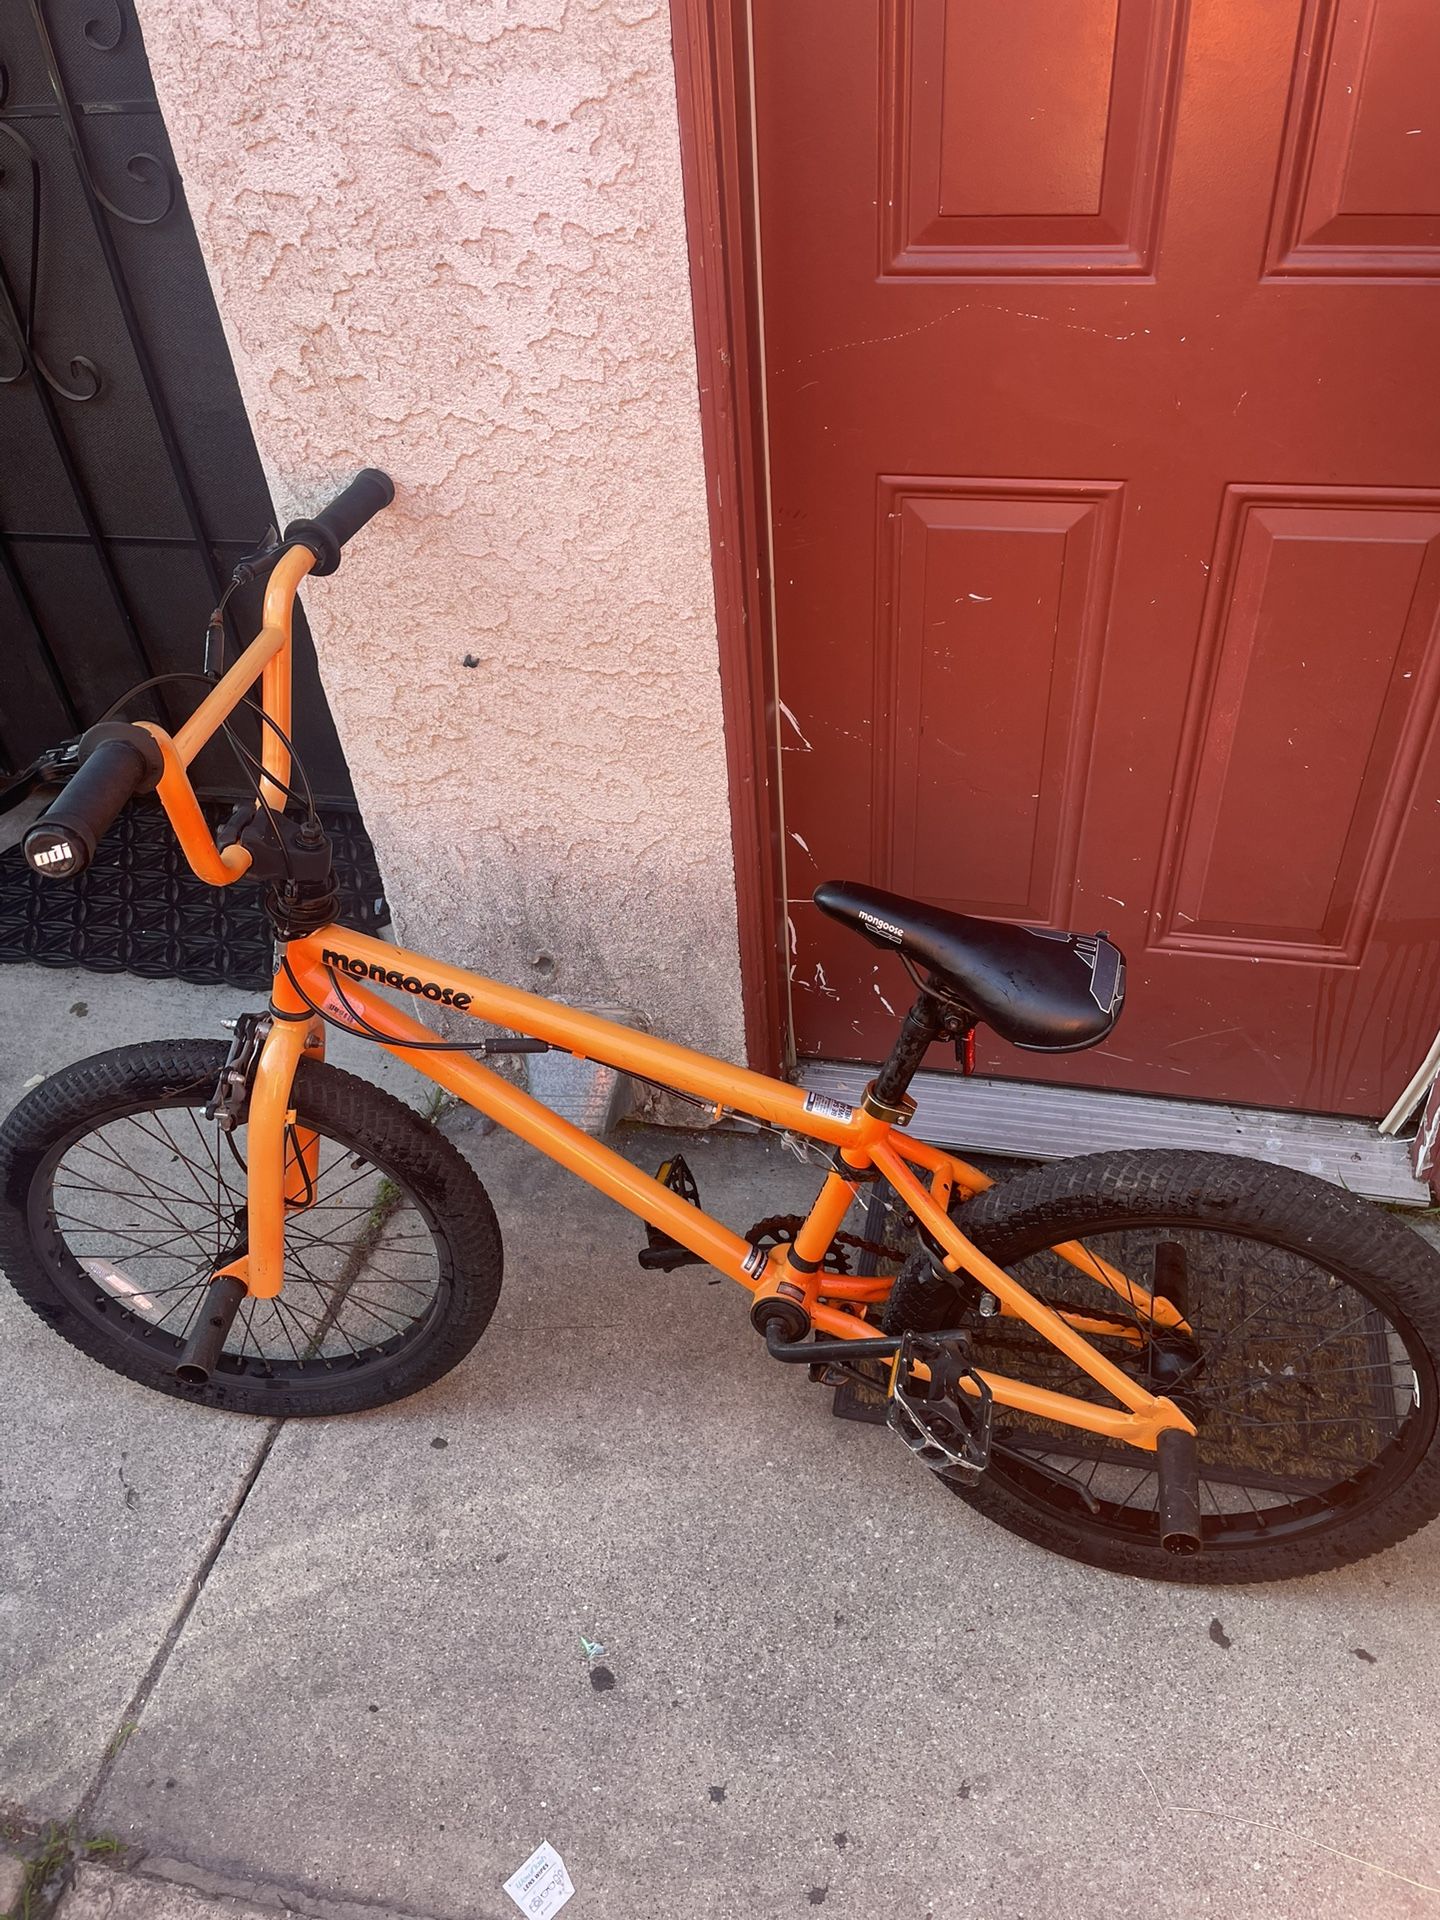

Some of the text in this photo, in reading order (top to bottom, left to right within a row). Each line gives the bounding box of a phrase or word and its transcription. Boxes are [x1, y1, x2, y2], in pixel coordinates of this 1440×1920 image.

[34, 842, 73, 867] odi
[859, 910, 904, 937] mongoose
[323, 949, 472, 1011] mongoose
[523, 1878, 536, 1892] LENS
[534, 1863, 549, 1879] WIPES
